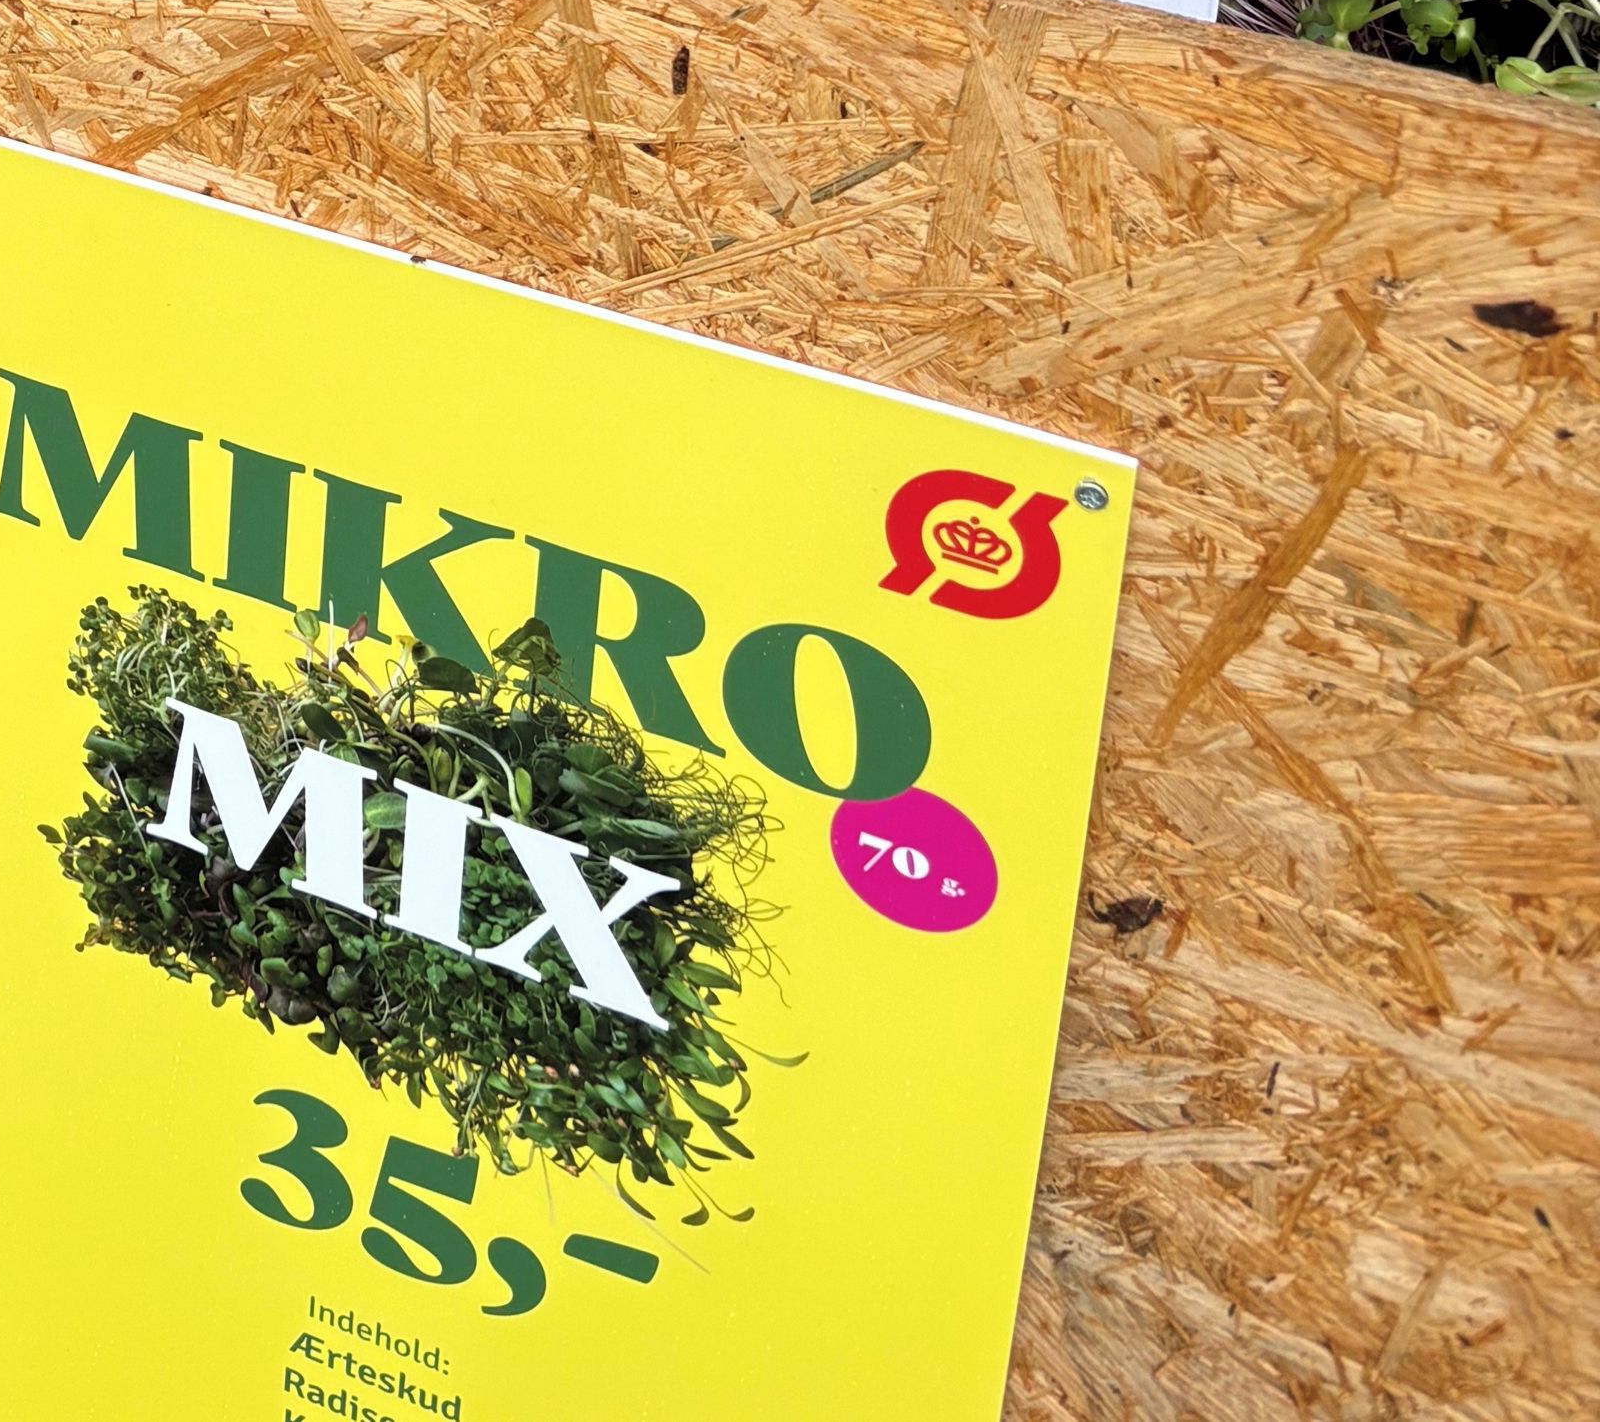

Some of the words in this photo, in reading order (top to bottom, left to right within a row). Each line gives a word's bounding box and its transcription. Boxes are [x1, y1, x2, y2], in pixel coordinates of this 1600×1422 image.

[146, 696, 681, 1032] MIX
[858, 831, 930, 880] 70
[239, 1088, 660, 1317] 35,-
[288, 1332, 462, 1422] Ærteskud
[308, 1295, 450, 1375] Indehold:
